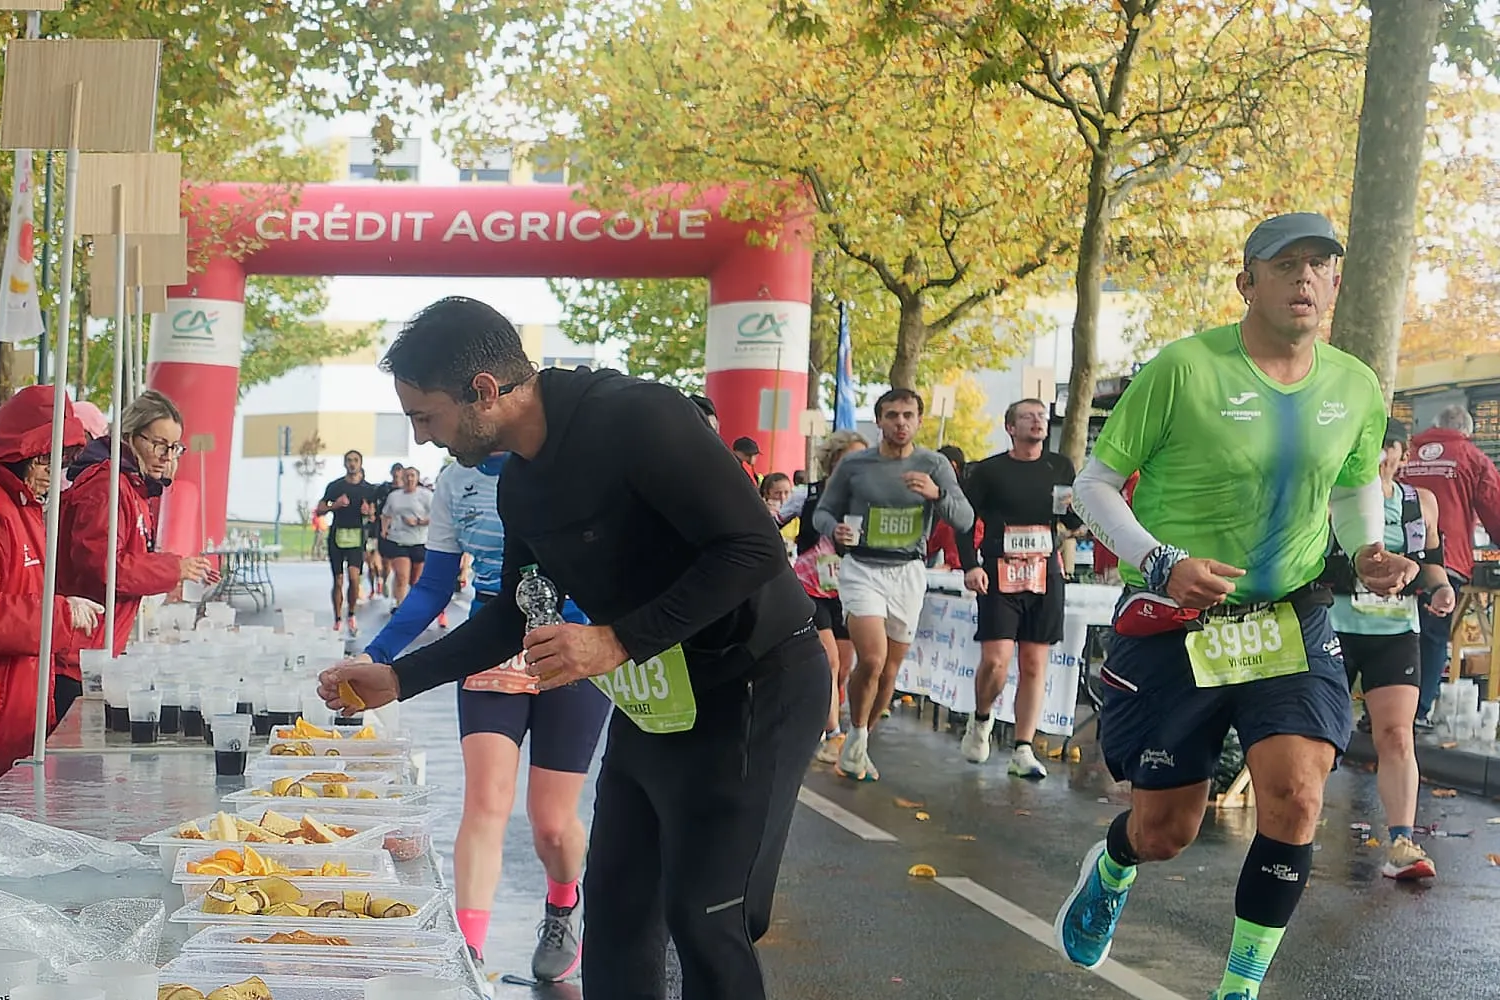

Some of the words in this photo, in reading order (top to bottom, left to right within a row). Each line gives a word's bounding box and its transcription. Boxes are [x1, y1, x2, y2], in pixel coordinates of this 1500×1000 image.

[255, 203, 434, 242] CRÉDIT
[441, 208, 711, 243] AGRICOLE
[1011, 535, 1036, 549] 6484
[1202, 618, 1282, 661] 3993
[1228, 655, 1264, 668] VINCENT
